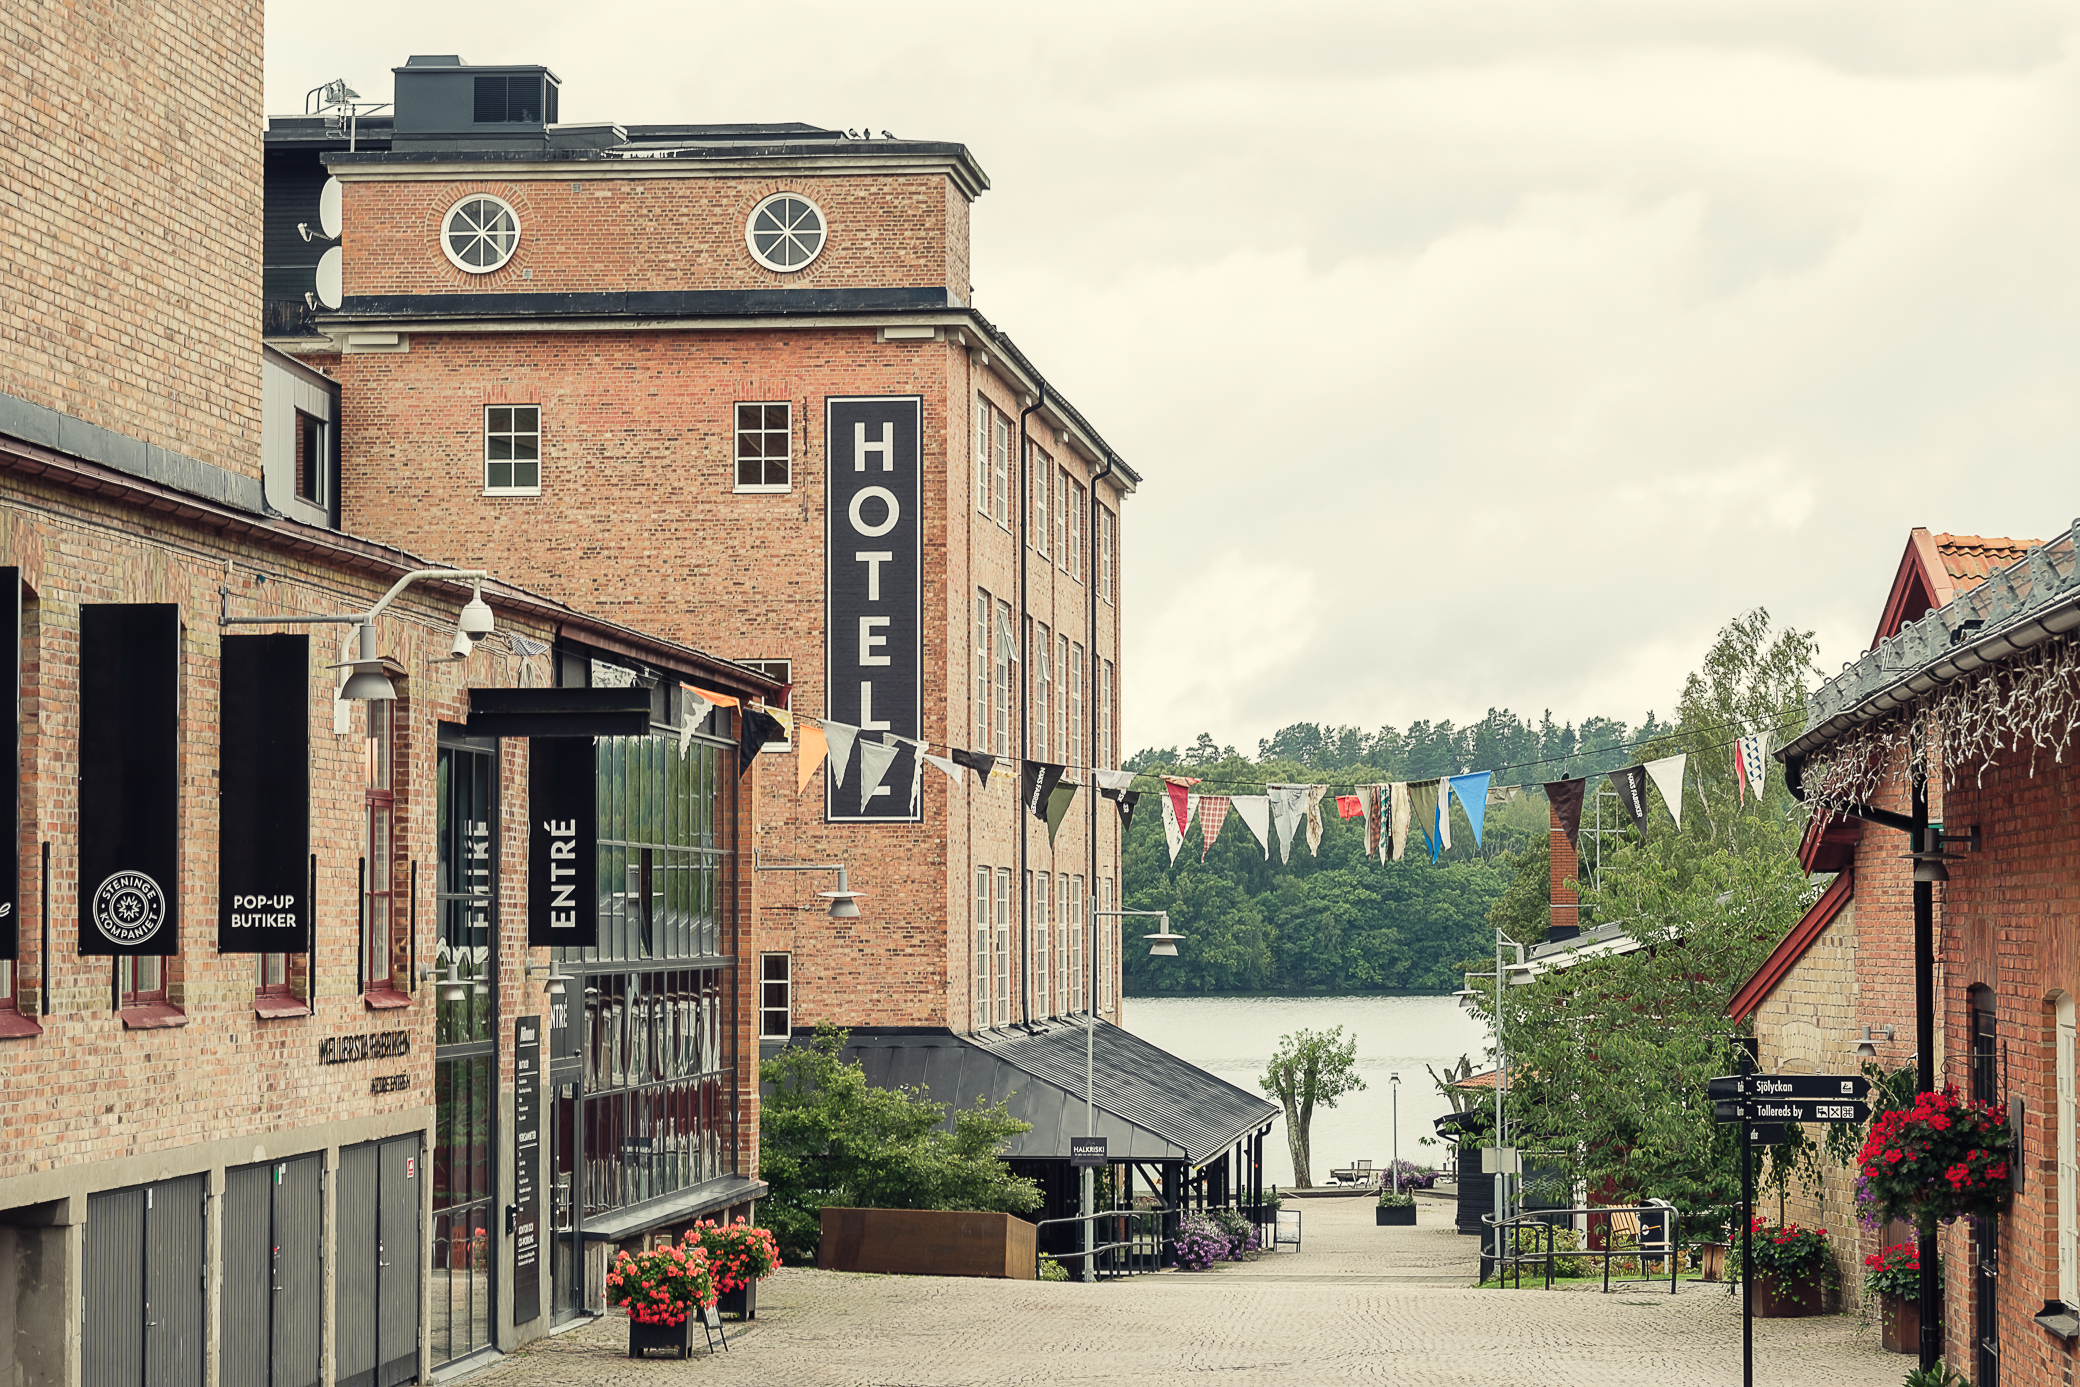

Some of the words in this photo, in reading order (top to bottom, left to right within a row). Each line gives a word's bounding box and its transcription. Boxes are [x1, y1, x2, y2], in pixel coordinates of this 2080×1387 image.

[544, 819, 576, 928] ENTRÉ
[102, 876, 157, 901] STENINGE
[233, 895, 295, 909] POP-UP
[99, 910, 159, 940] KOMPANIET
[231, 913, 297, 928] BUTIKER
[550, 996, 568, 1029] NTRÉ
[318, 1033, 368, 1067] MELLERSTA
[369, 1029, 411, 1059] FABRIKEN
[1756, 1079, 1793, 1095] Sjölyckan
[1757, 1104, 1792, 1117] Tollereds
[1792, 1104, 1803, 1119] by
